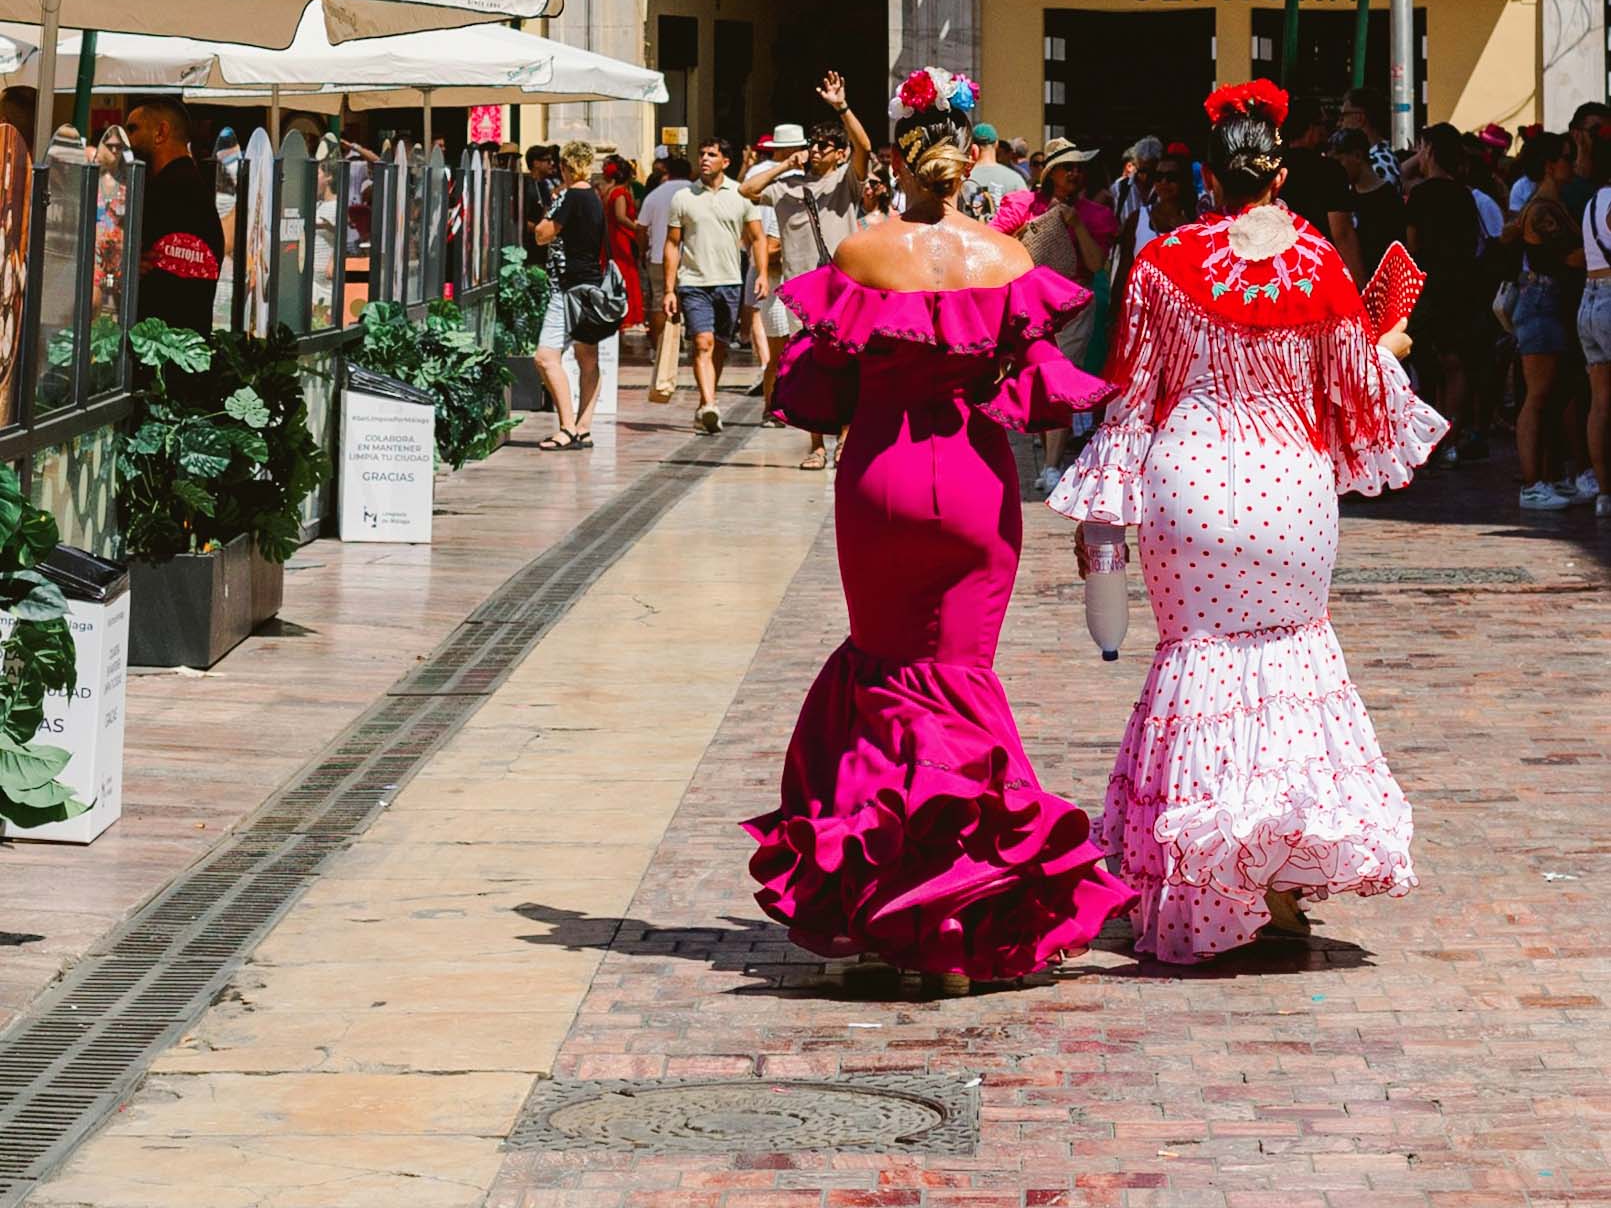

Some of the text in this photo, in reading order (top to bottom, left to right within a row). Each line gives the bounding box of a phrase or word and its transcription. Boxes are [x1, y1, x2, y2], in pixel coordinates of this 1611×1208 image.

[164, 245, 204, 263] CARTOJAL
[365, 434, 415, 443] COLABORA
[372, 444, 422, 452] MANTENER
[349, 452, 379, 461] LIMPIA
[394, 454, 430, 462] CIUDAD
[362, 471, 415, 483] GRACIAS
